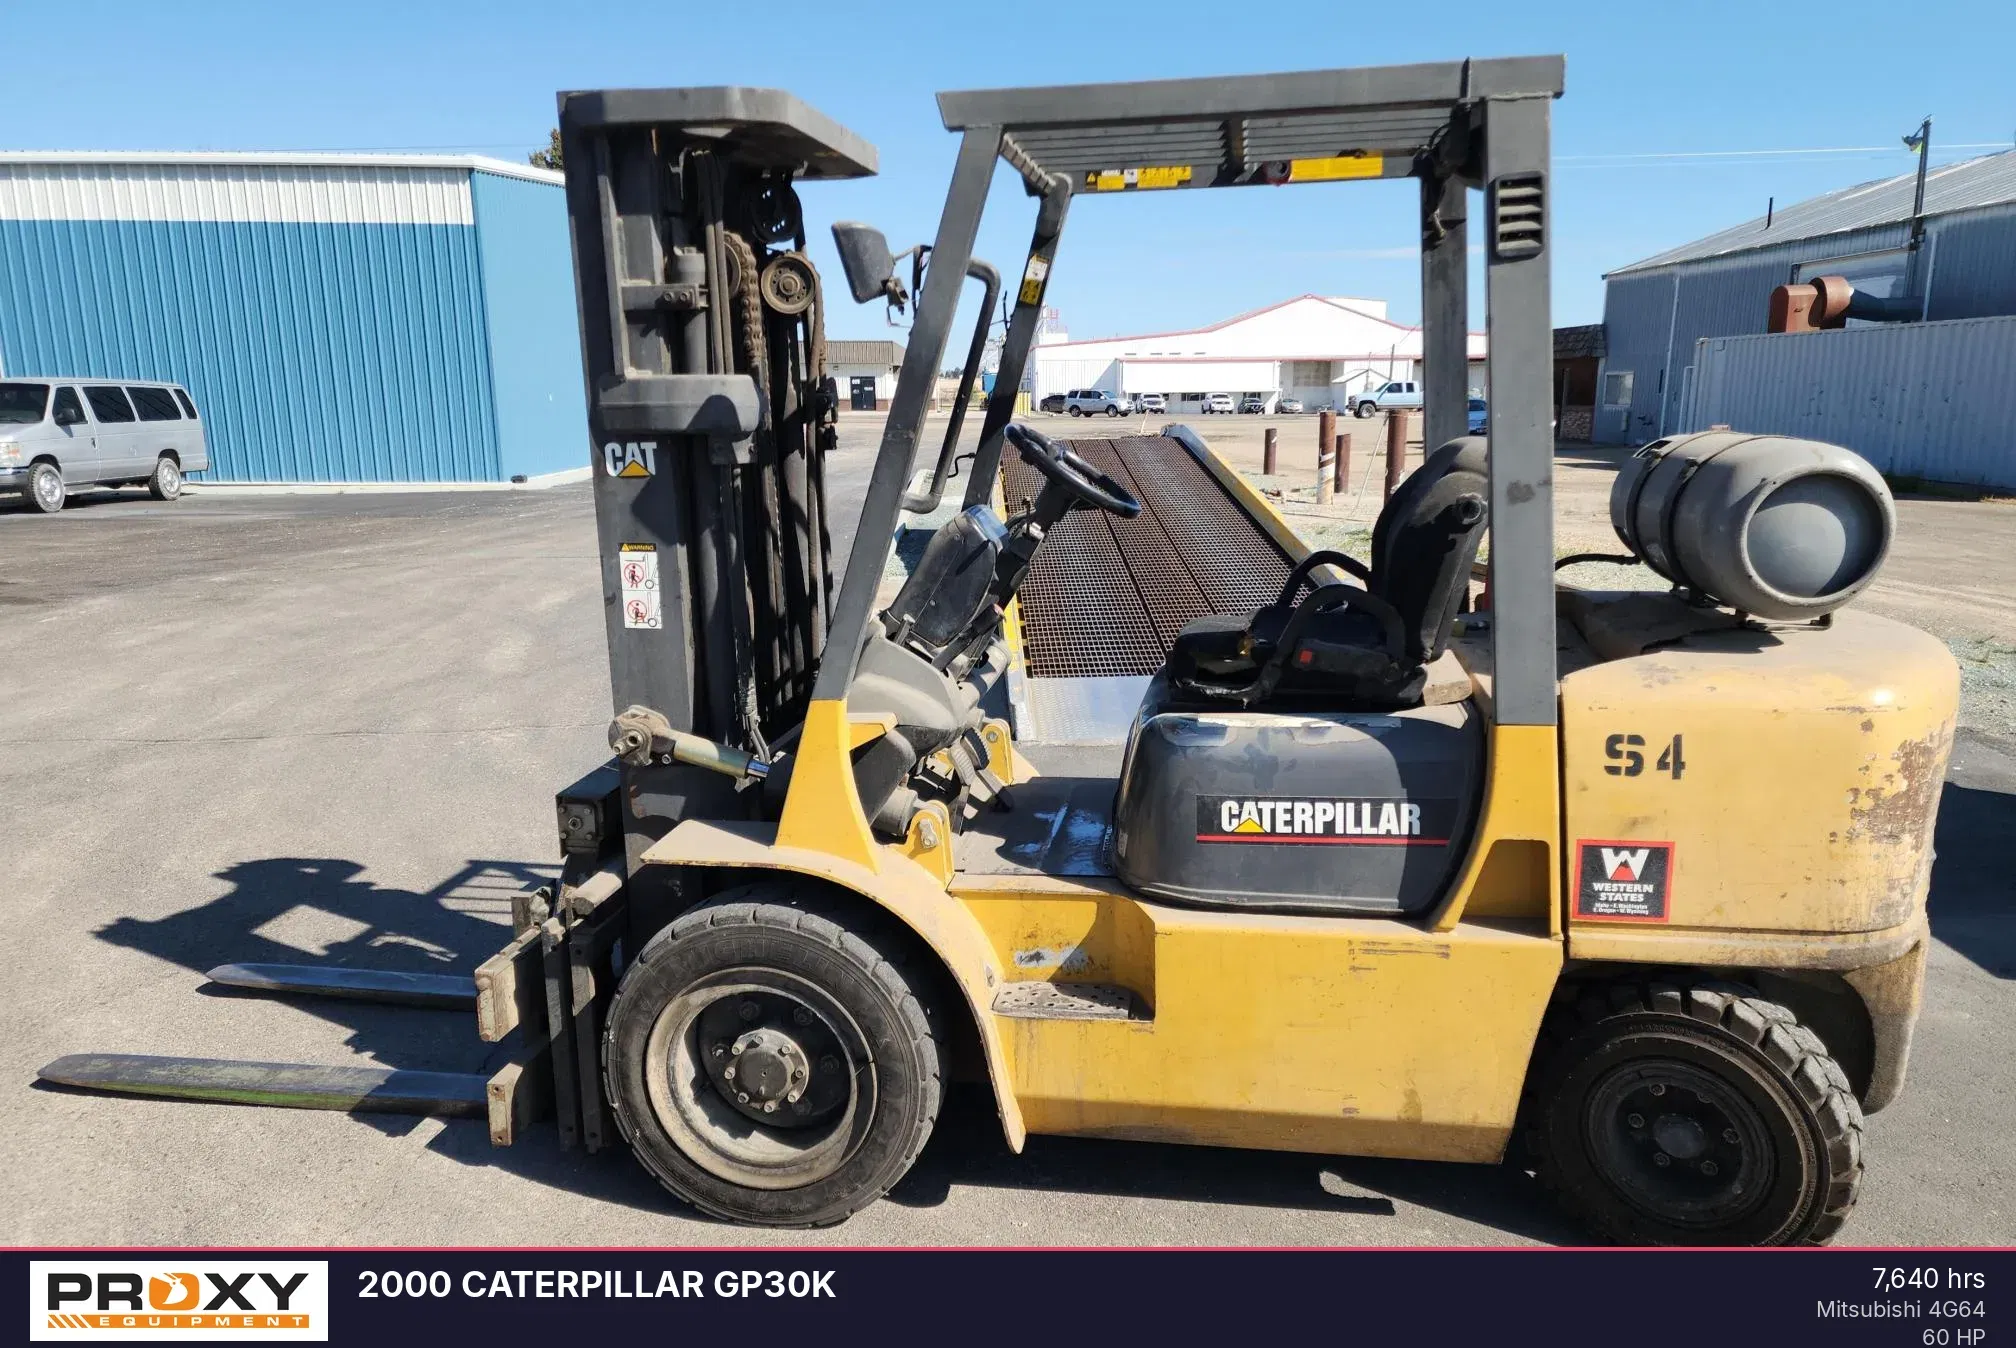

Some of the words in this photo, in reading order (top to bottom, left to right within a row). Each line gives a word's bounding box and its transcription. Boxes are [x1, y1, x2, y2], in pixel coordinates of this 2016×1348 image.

[604, 442, 657, 477] CAT
[1221, 800, 1421, 835] CATERPILLAR
[1601, 848, 1649, 880] W
[1593, 882, 1654, 893] WESTERN
[1599, 892, 1644, 902] STATES
